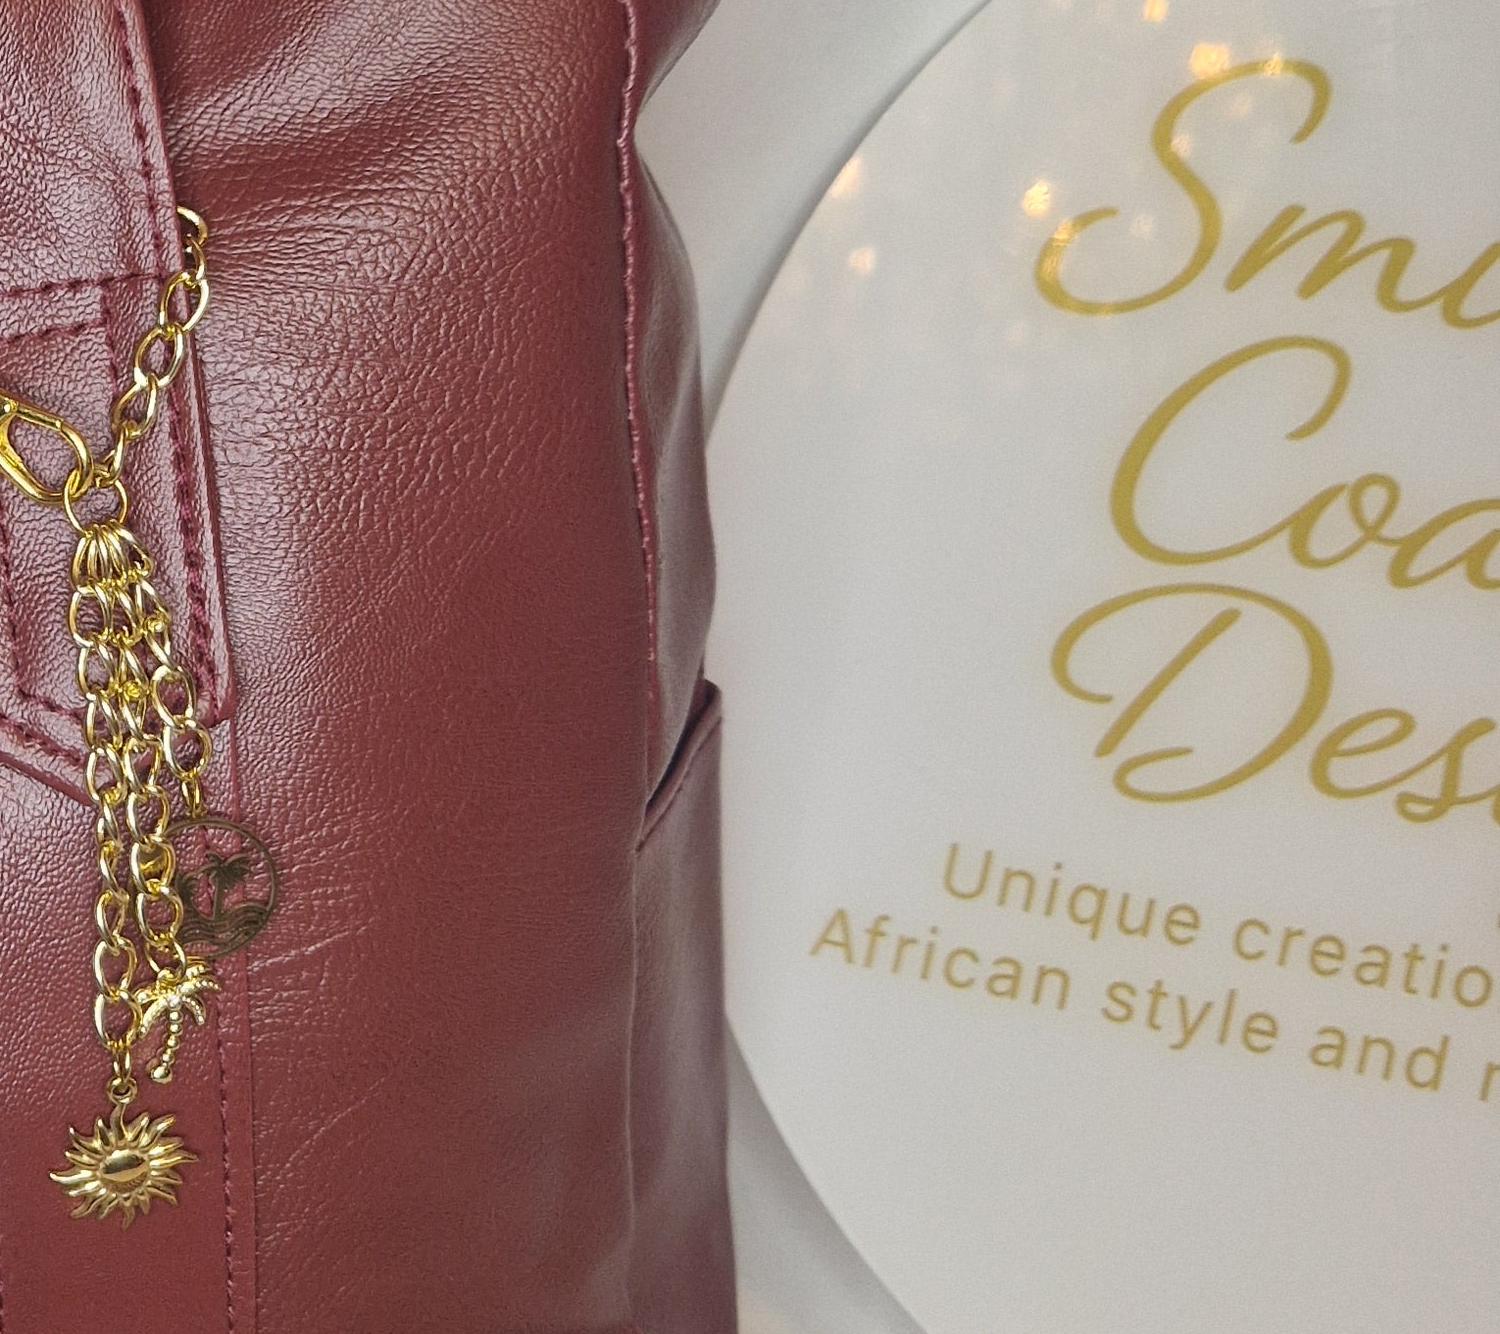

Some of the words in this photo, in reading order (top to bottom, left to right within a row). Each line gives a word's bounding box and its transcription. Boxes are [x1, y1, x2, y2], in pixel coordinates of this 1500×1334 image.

[1050, 582, 1500, 824] Des
[809, 908, 1070, 1011] African
[1101, 978, 1279, 1055] style
[1309, 1025, 1450, 1091] and
[942, 842, 1201, 946] Unique
[1232, 918, 1493, 1008] creatio
